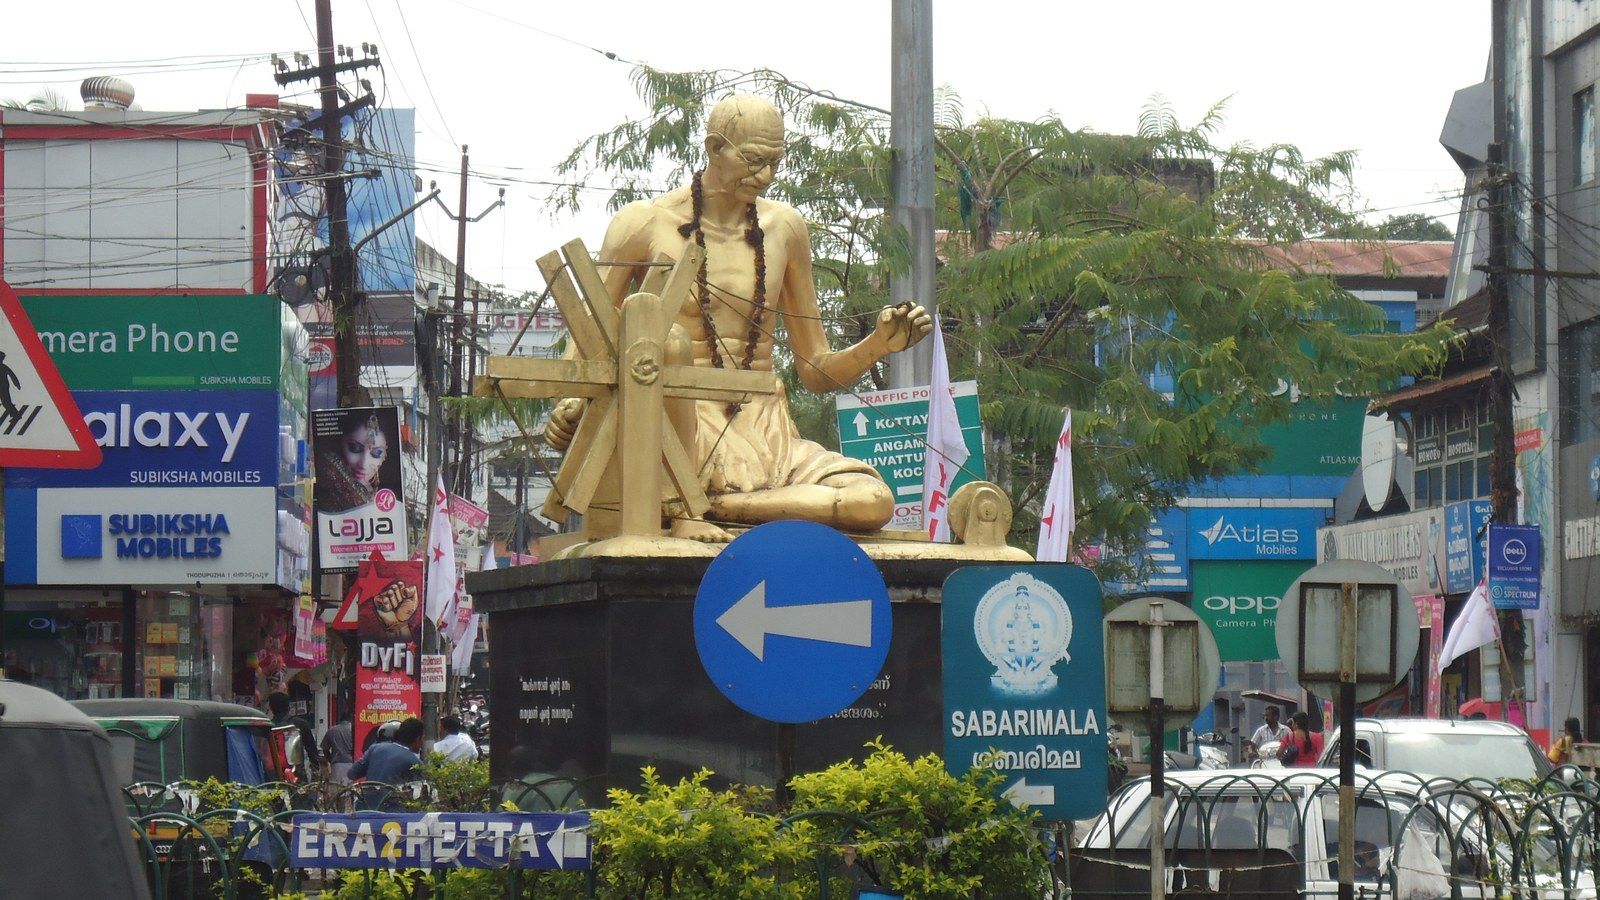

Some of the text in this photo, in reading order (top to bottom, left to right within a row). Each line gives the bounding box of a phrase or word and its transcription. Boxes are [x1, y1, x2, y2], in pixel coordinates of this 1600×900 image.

[37, 323, 239, 353] mera Phone
[200, 376, 271, 384] SUBIKSHA MOBILES
[860, 391, 909, 405] TRAFFIC
[84, 404, 249, 462] alaxy
[1320, 455, 1345, 464] ATLAS
[130, 471, 260, 483] SUBIKSHA MOBILES
[893, 467, 924, 479] KOC
[109, 514, 230, 535] SUBIKSHA
[1218, 524, 1298, 543] Atlas
[116, 538, 222, 559] MOBILES
[1256, 545, 1297, 555] Mobiles
[1506, 547, 1524, 555] DELL
[1503, 590, 1537, 599] SPECTRUM
[1216, 619, 1256, 628] Camera
[952, 709, 1099, 737] SABARIMALA
